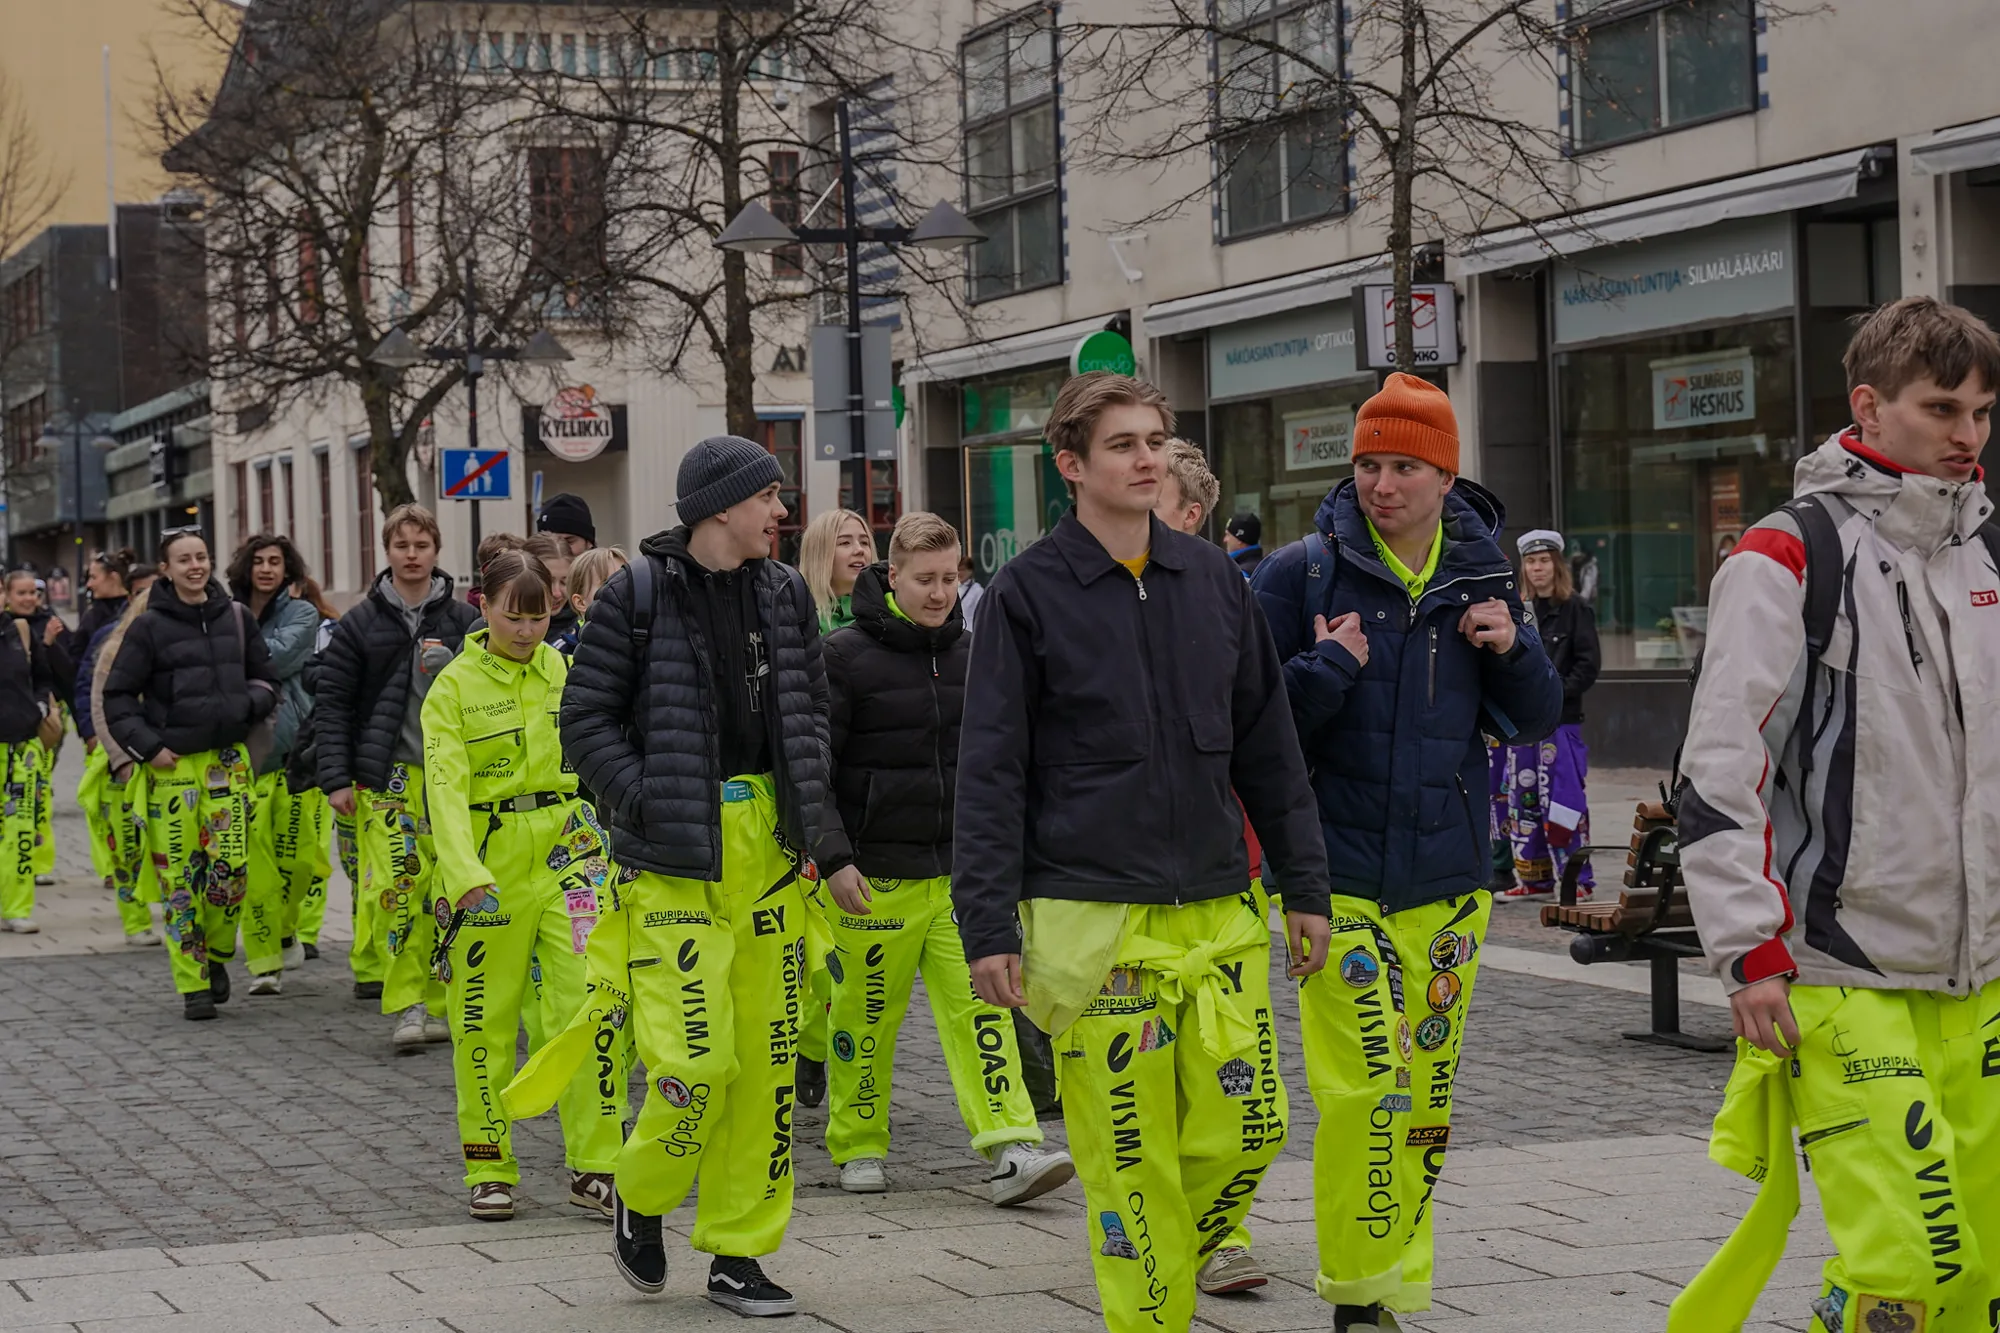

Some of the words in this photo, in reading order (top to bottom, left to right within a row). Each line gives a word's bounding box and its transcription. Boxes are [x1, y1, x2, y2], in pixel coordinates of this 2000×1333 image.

[1687, 250, 1783, 286] SILMÄLÄÄKÄRI
[1386, 350, 1439, 362] OKKO
[1689, 369, 1744, 391] SILMÄLASI
[1690, 390, 1745, 418] KESKUS
[542, 419, 609, 438] KYLLIKKI
[1310, 439, 1349, 461] KESKUS
[168, 818, 183, 864] VISMA
[643, 910, 711, 921] VETURIPALVELU
[752, 904, 786, 937] EY
[840, 915, 905, 926] VETURIPALVELU
[464, 972, 485, 1034] VISMA
[681, 978, 711, 1060] VISMA
[865, 969, 885, 1025] VISMA
[769, 1019, 789, 1067] MER
[1354, 988, 1393, 1080] VISMA
[1428, 1060, 1450, 1110] MER
[1109, 1080, 1143, 1173] VISMA
[1241, 1099, 1265, 1152] MER
[1915, 1158, 1963, 1285] VISMA
